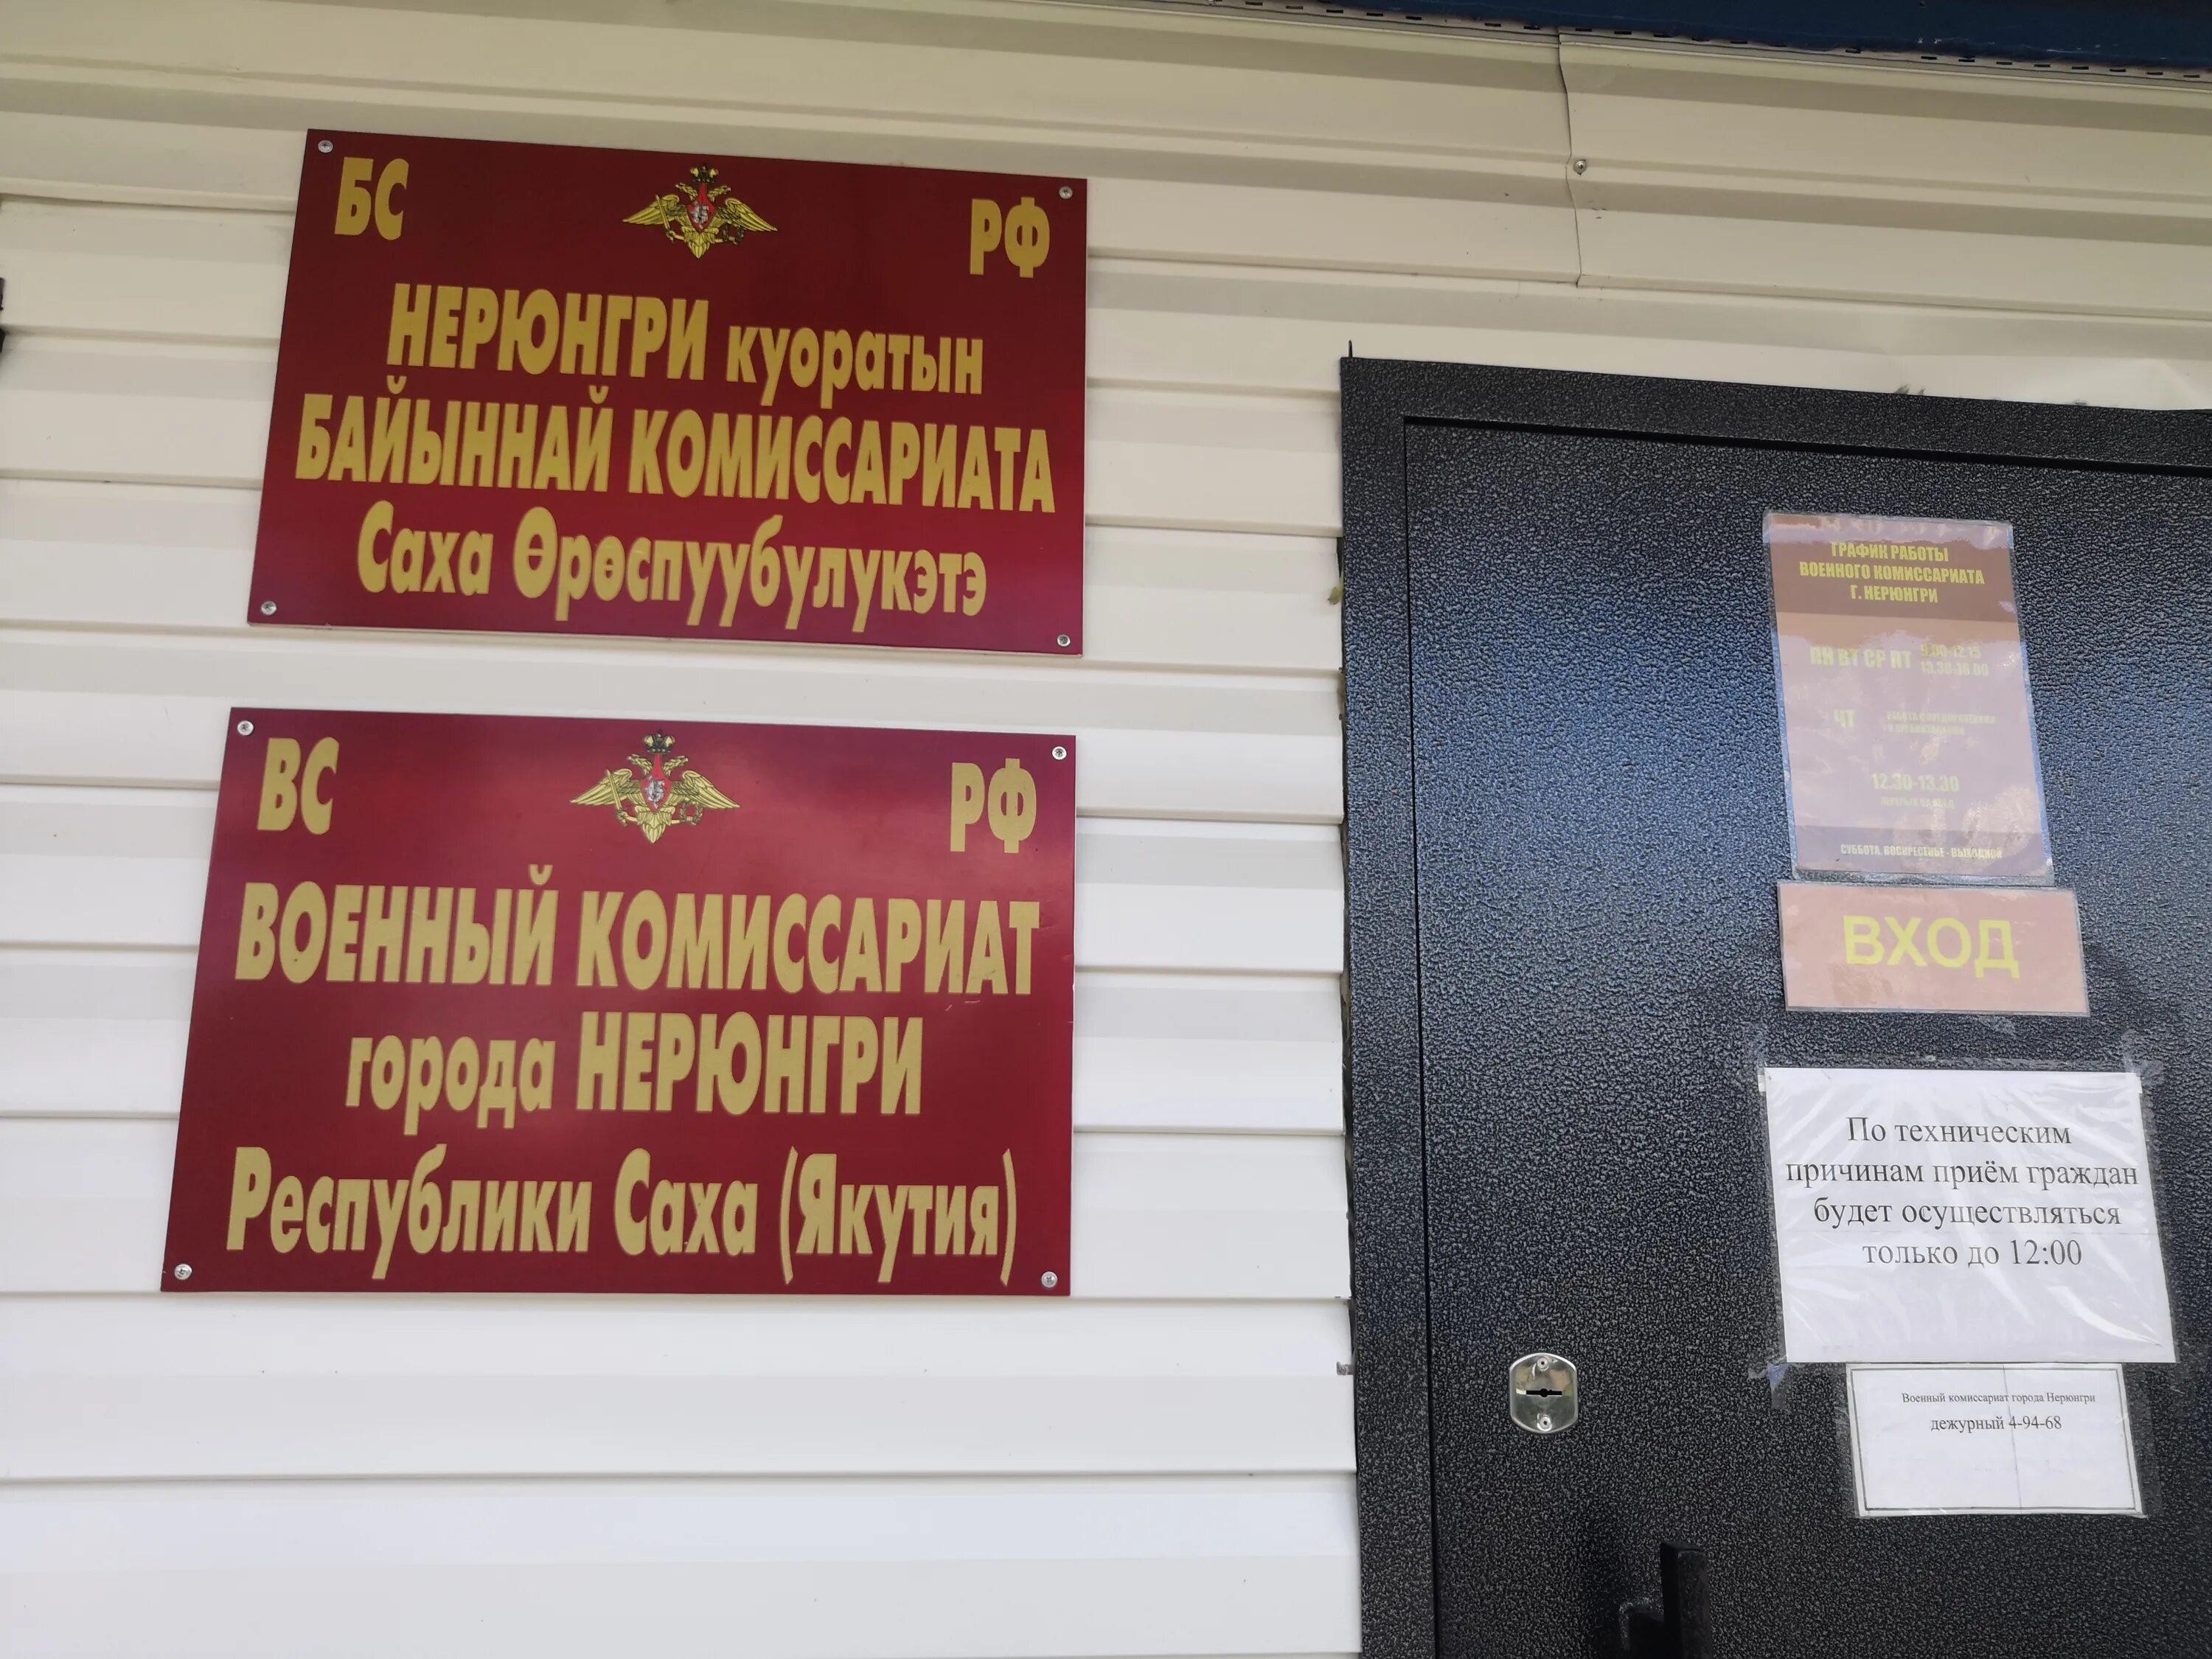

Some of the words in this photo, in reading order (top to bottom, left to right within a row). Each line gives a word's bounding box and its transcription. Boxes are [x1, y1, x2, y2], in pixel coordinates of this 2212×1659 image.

[334, 156, 409, 240] БС
[970, 197, 1050, 278] РФ
[386, 282, 709, 380] НЕРЮНГРИ
[726, 325, 984, 410] куоратын
[295, 375, 614, 493] БАЙЫННАЙ
[627, 408, 1056, 513] КОМИССАРИАТА
[357, 500, 494, 596] Саха
[1831, 542, 1888, 559] ГРАФИК
[1891, 544, 1949, 562] РАБОТЫ
[1799, 561, 1871, 579] ВОЕННОГО
[1873, 565, 1985, 585] КОМИССАРИАТА
[1850, 585, 1862, 599] Г.
[1864, 585, 1938, 602] НЕРЮНГРИ
[1809, 647, 1834, 665] ПН
[1838, 647, 1859, 667] ВТ
[1863, 649, 1885, 668] СР
[1889, 650, 1912, 669] ПТ
[257, 737, 339, 835] ВС
[1872, 773, 1960, 793] 12.30-13.30
[950, 759, 1037, 855] РФ
[1951, 847, 2003, 860] ВЫХОДНОЙ
[236, 864, 559, 987] ВОЕННЫЙ
[577, 890, 1040, 995] КОМИССАРИАТ
[1842, 914, 2021, 979] ВХОД
[346, 1034, 556, 1137] города
[577, 1011, 924, 1116] НЕРЮНГРИ
[1846, 1116, 1886, 1142] По
[1893, 1124, 2073, 1144] техническим
[1785, 1162, 1924, 1189] причинам
[1933, 1160, 2019, 1190] приём
[2025, 1166, 2138, 1192] граждан
[226, 1144, 593, 1279] Республики
[614, 1147, 758, 1256] Саха
[780, 1148, 1017, 1284] (Якутия)
[1814, 1196, 1893, 1230] будет
[1902, 1205, 2122, 1230] осуществляться
[1862, 1245, 1958, 1265] только
[1967, 1246, 2000, 1269] до
[2010, 1239, 2083, 1266] 12:00
[1901, 1392, 1946, 1403] Военный
[1948, 1394, 2010, 1405] комиссариат
[2011, 1395, 2045, 1405] города
[2046, 1392, 2096, 1405] Нерюнгри
[1930, 1416, 2005, 1434] дежурный
[2008, 1415, 2063, 1430] 4-94-68
